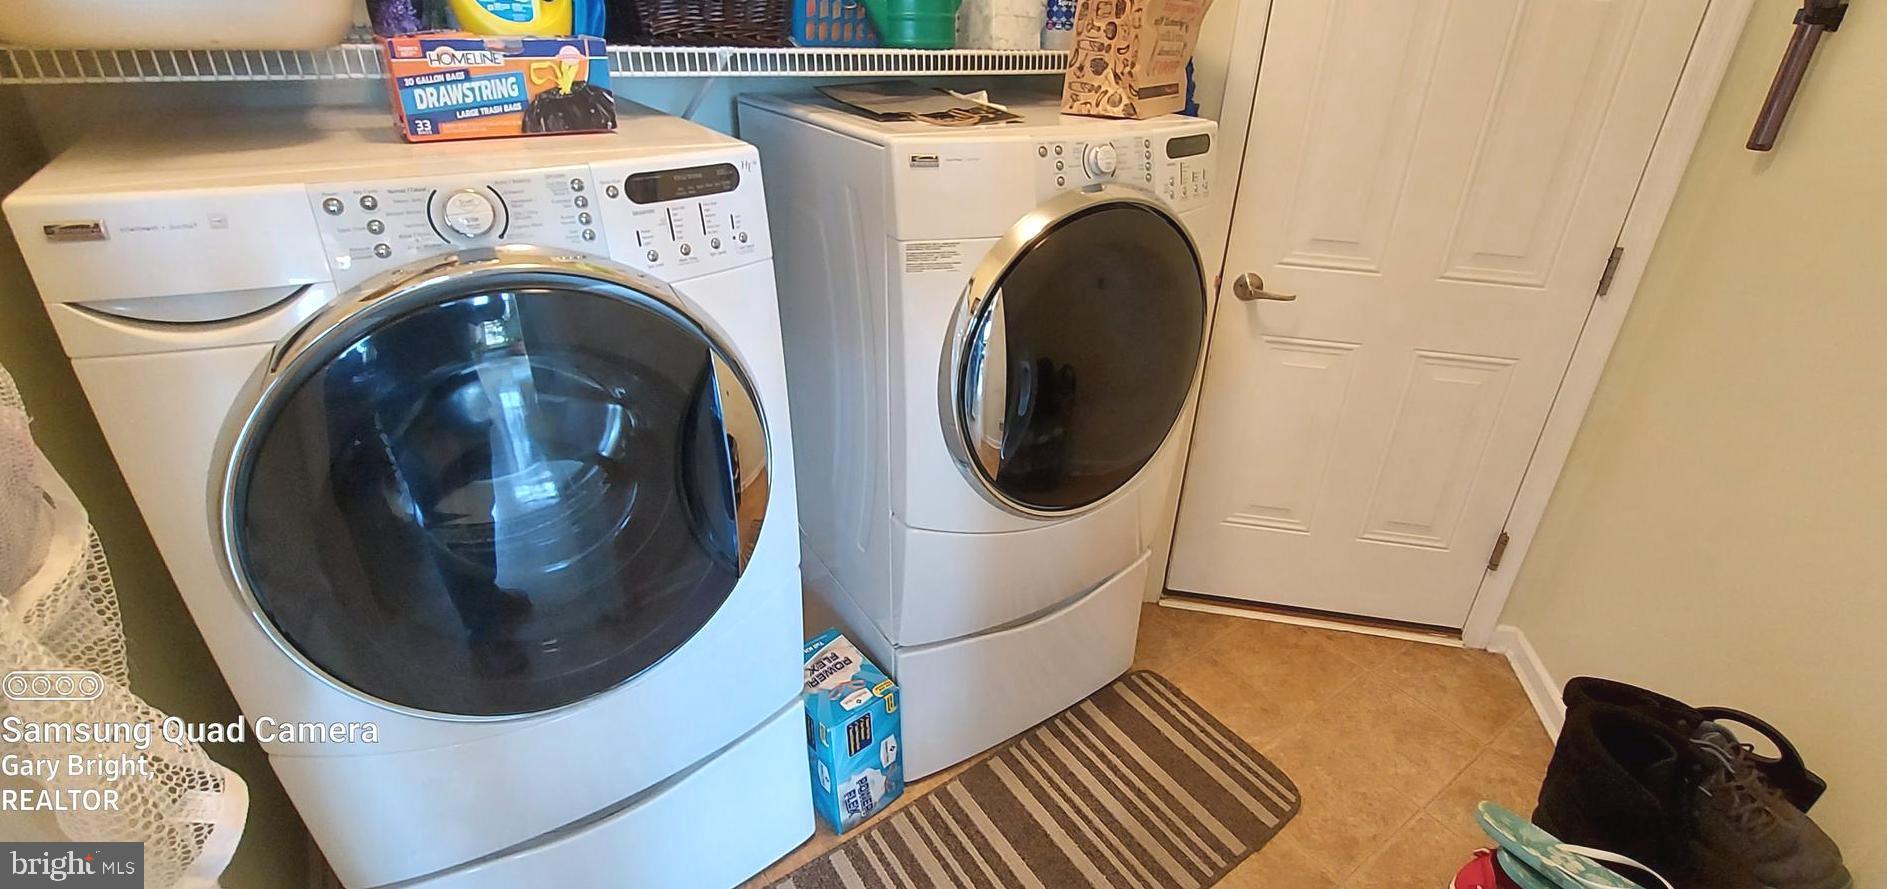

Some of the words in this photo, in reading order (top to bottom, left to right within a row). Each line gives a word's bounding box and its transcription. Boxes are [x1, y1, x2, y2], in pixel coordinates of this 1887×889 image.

[428, 52, 502, 66] HOMELINE
[416, 73, 445, 85] GALLON
[446, 71, 465, 82] BAGS
[413, 76, 519, 110] DRAWSTRING
[456, 108, 480, 119] LARGE
[480, 105, 503, 117] TRASH
[503, 102, 522, 113] BAGS
[415, 120, 431, 131] 33
[806, 651, 840, 677] FLEX
[807, 656, 853, 689] POWER
[844, 789, 861, 819] FLEX
[856, 775, 874, 816] POWER
